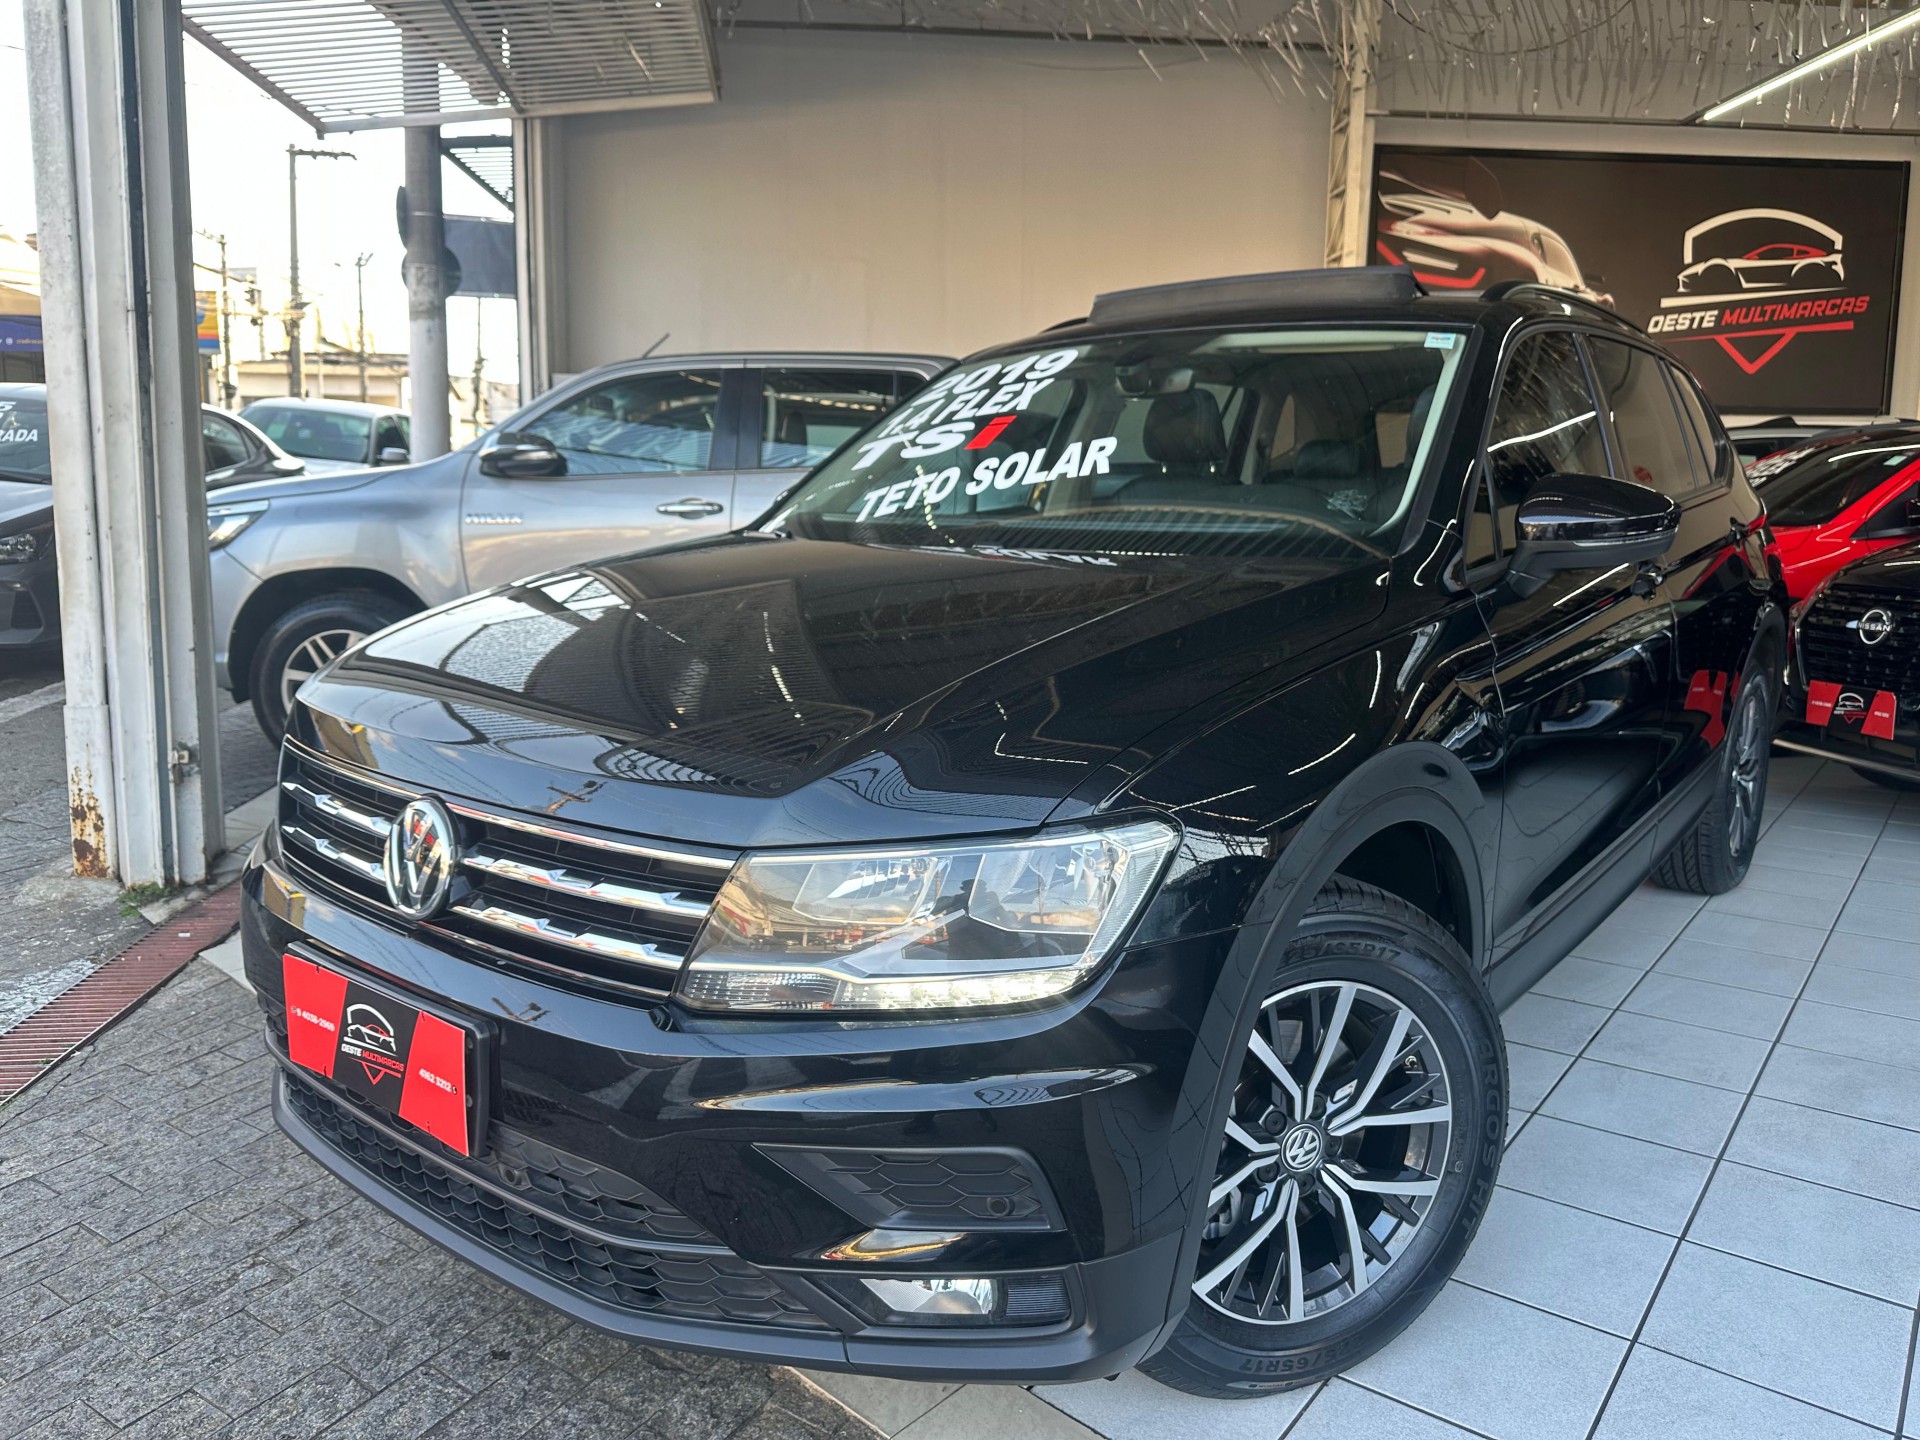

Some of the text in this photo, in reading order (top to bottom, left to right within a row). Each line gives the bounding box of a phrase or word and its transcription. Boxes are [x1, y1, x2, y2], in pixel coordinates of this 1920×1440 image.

[1647, 295, 1871, 334] OESTE MULTIMARCAS
[911, 349, 1079, 407] 2019
[930, 377, 1056, 426] FLEX
[855, 436, 1118, 523] TETO SOLAR
[1858, 621, 1892, 632] NISSAN
[341, 1043, 405, 1072] OESTE MULTIMARCAS
